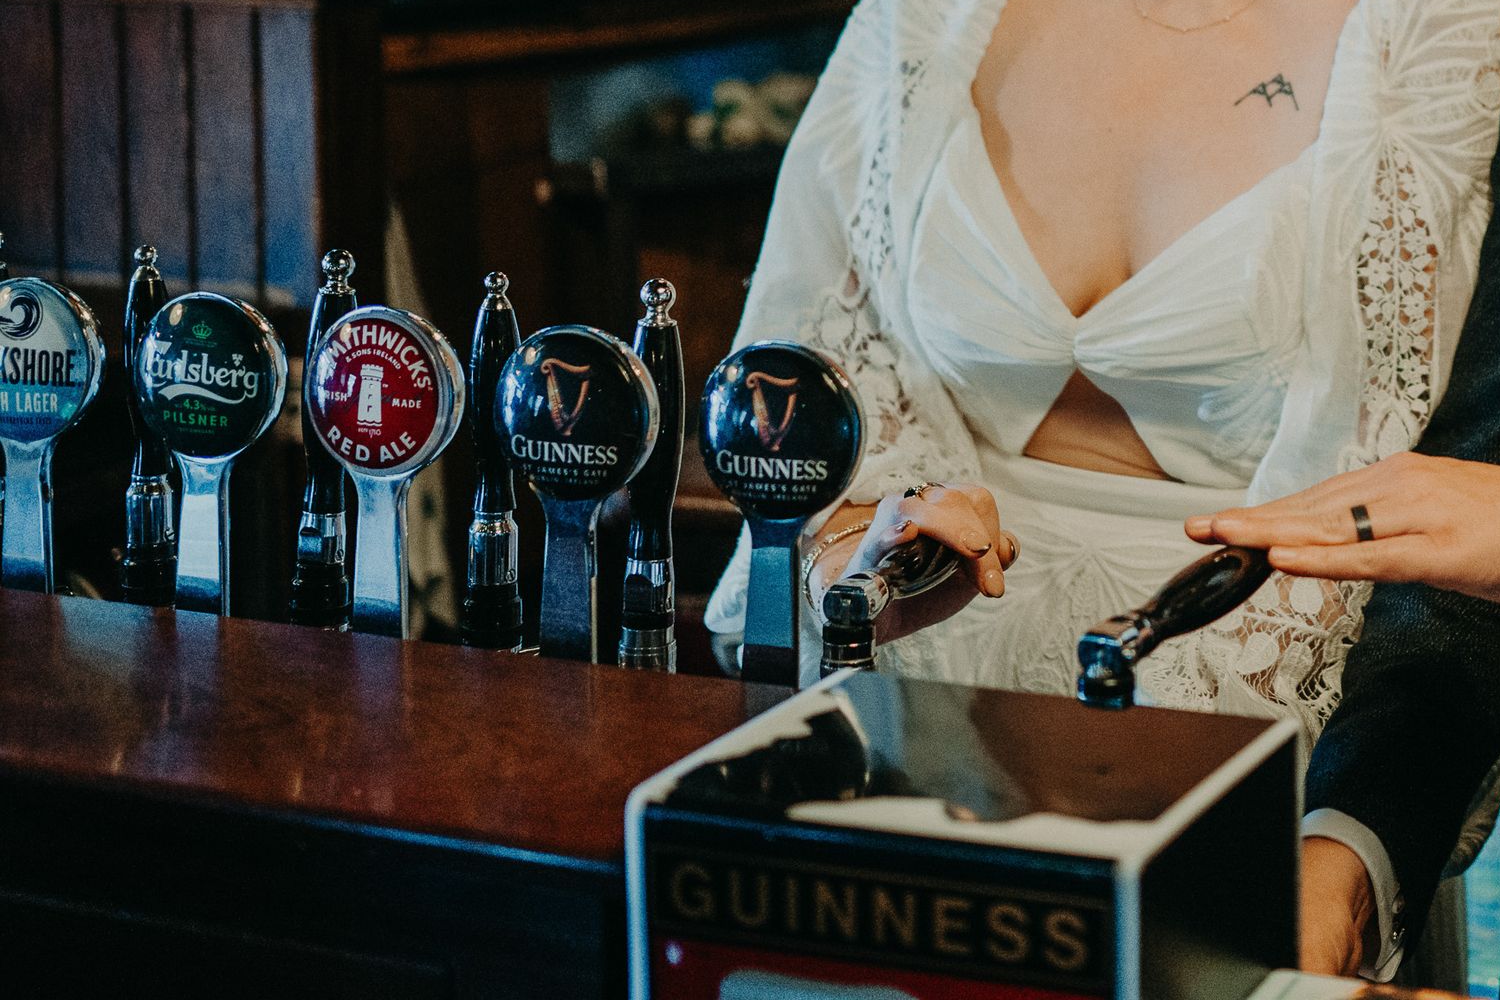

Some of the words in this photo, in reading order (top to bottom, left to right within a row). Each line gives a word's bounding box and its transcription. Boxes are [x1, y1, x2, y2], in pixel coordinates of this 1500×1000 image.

[141, 340, 259, 400] Carlsberg
[373, 349, 402, 370] IRELAND
[15, 391, 58, 413] LAGER
[392, 398, 422, 409] MADE
[163, 410, 228, 427] PILSNER
[327, 425, 370, 461] RED
[379, 431, 416, 463] ALE
[511, 434, 618, 466] GUINNESS
[716, 449, 828, 481] GUINNESS
[671, 862, 1088, 970] GUINNESS
